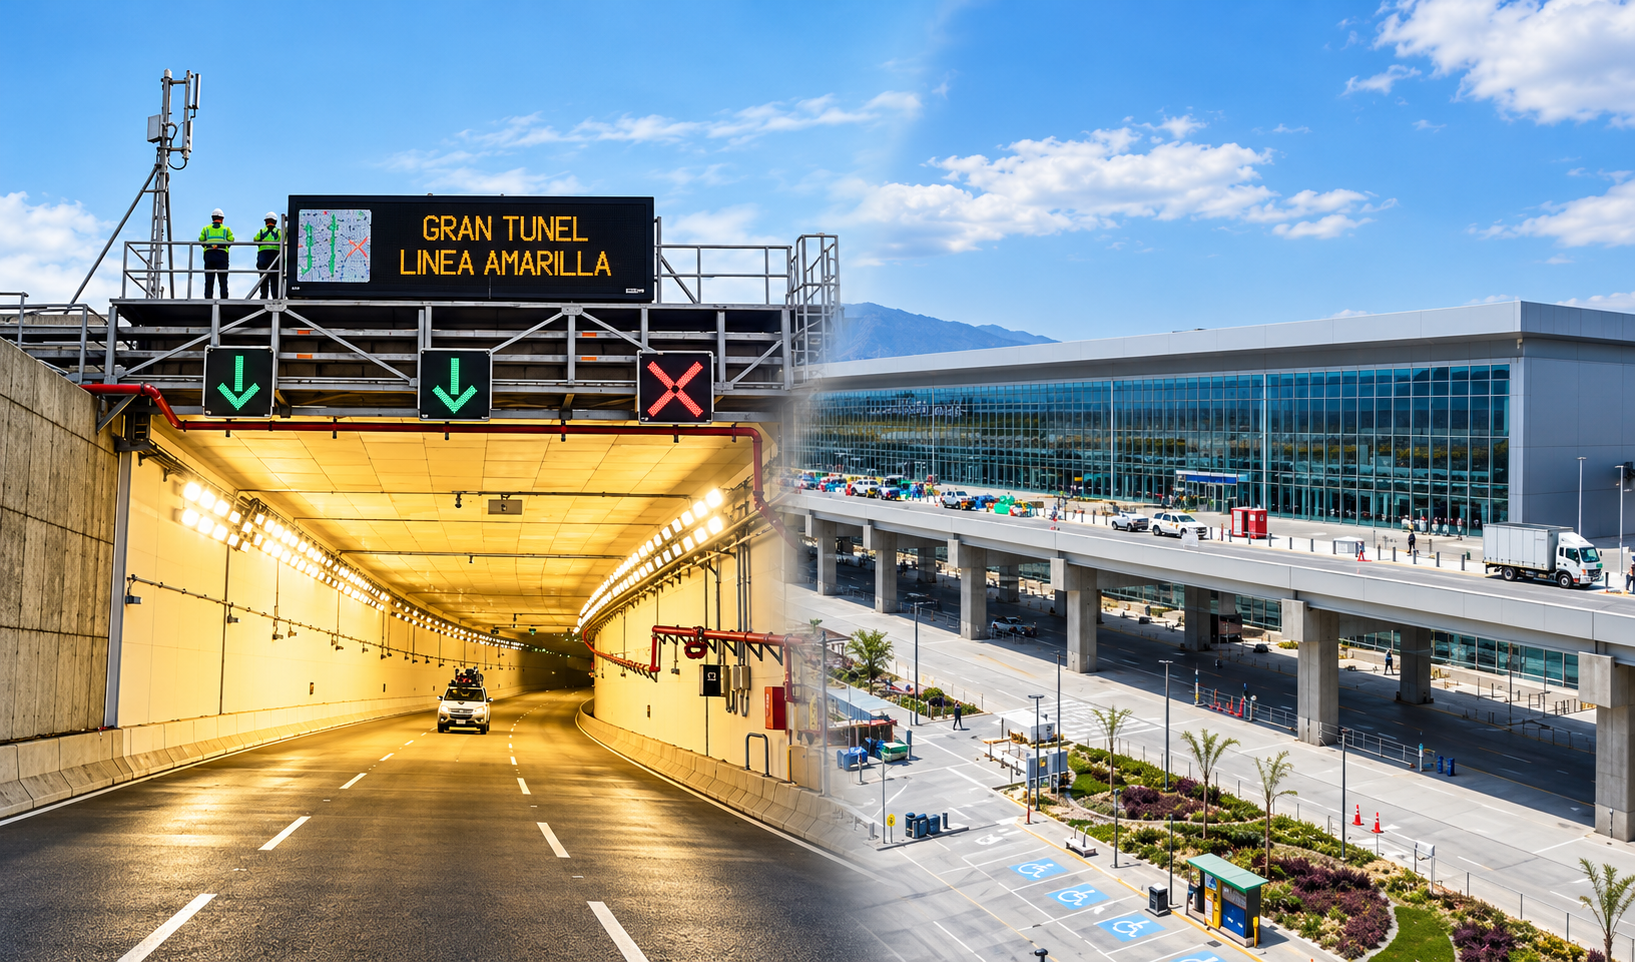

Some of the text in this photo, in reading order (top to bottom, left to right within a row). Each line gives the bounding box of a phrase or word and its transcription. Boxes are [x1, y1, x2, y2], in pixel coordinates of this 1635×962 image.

[422, 215, 589, 241] GRAN TUNEL
[400, 249, 611, 276] LINEA AMARILLA
